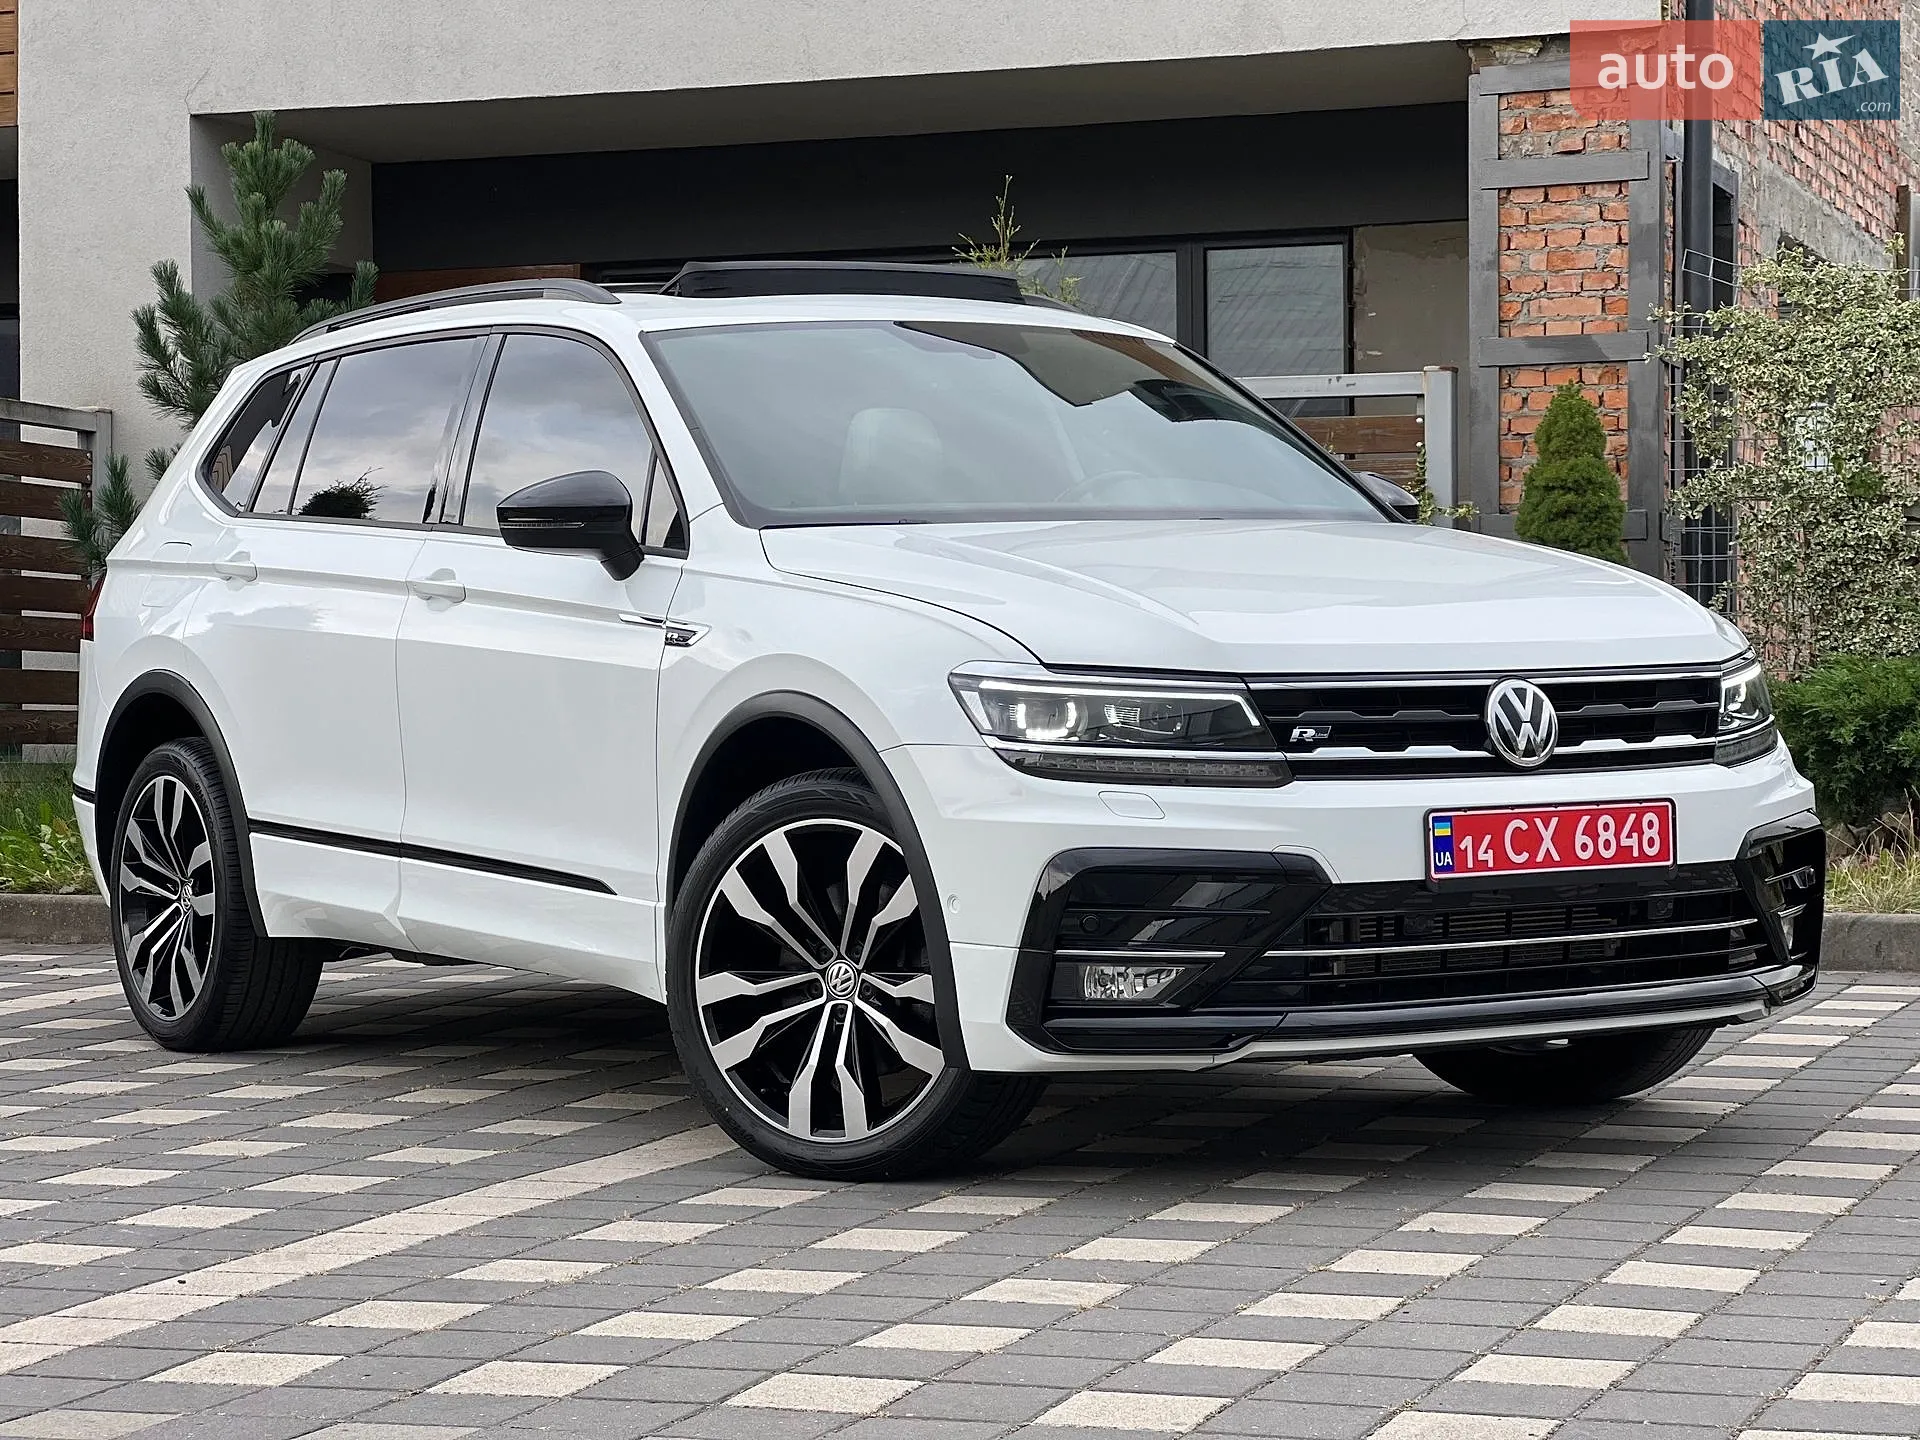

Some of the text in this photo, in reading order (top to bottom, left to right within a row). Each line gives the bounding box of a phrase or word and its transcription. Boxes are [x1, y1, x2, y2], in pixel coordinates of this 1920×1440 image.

[1459, 812, 1661, 869] 14 CX 6848
[1435, 851, 1453, 867] UA
